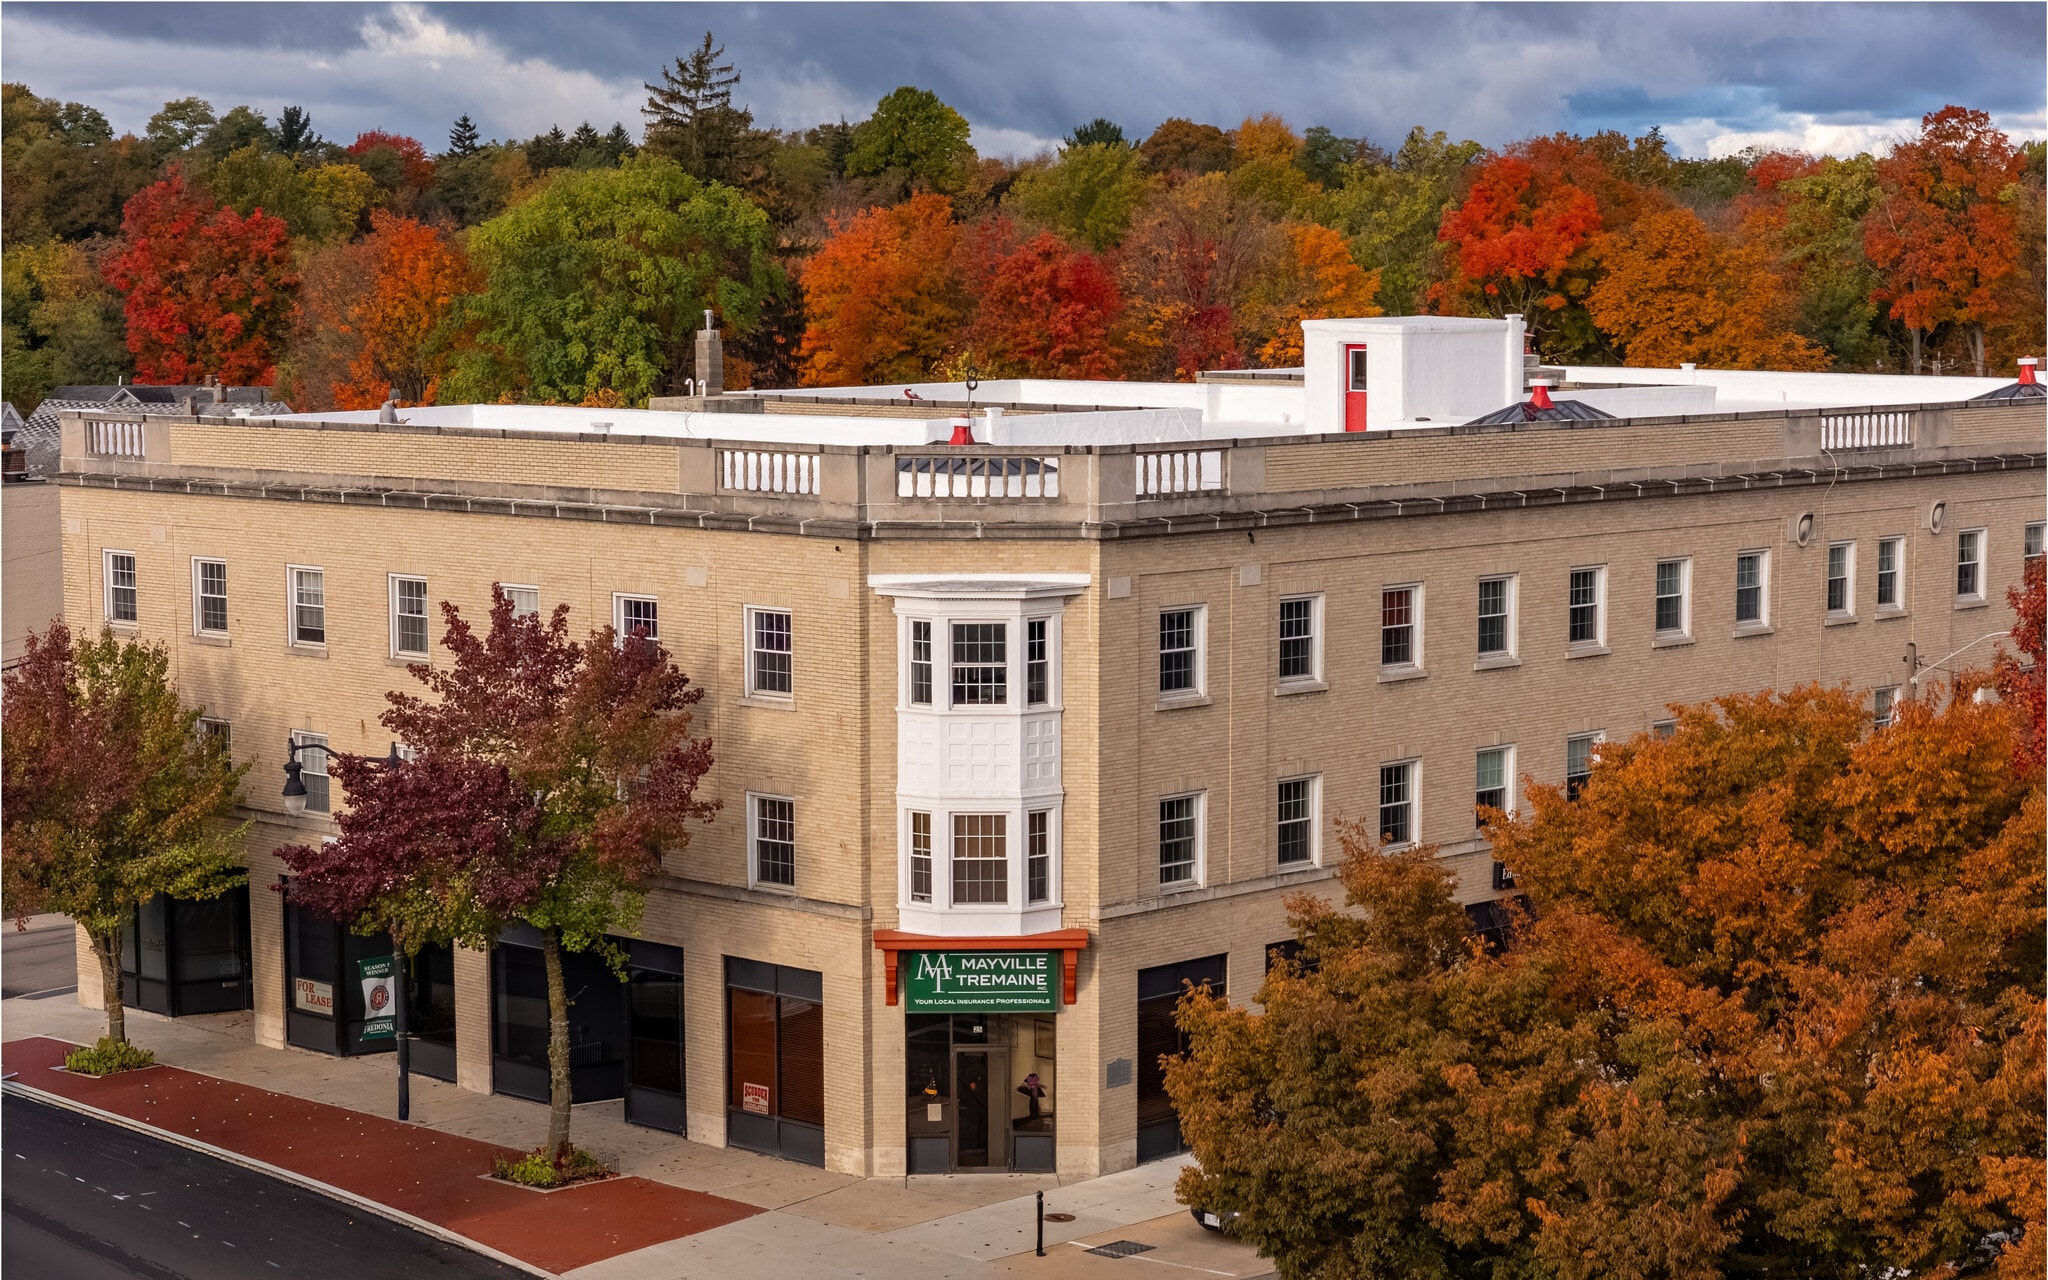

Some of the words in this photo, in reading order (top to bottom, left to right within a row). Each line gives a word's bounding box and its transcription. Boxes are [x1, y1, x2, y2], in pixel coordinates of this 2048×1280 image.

[363, 963, 386, 971] SEASON
[961, 958, 1047, 970] MAYVILLE
[366, 967, 389, 976] WINNER
[956, 974, 1047, 986] TREMAINE
[297, 980, 315, 993] FOR
[305, 993, 332, 1008] LEASE
[363, 1022, 394, 1034] FREDONIA
